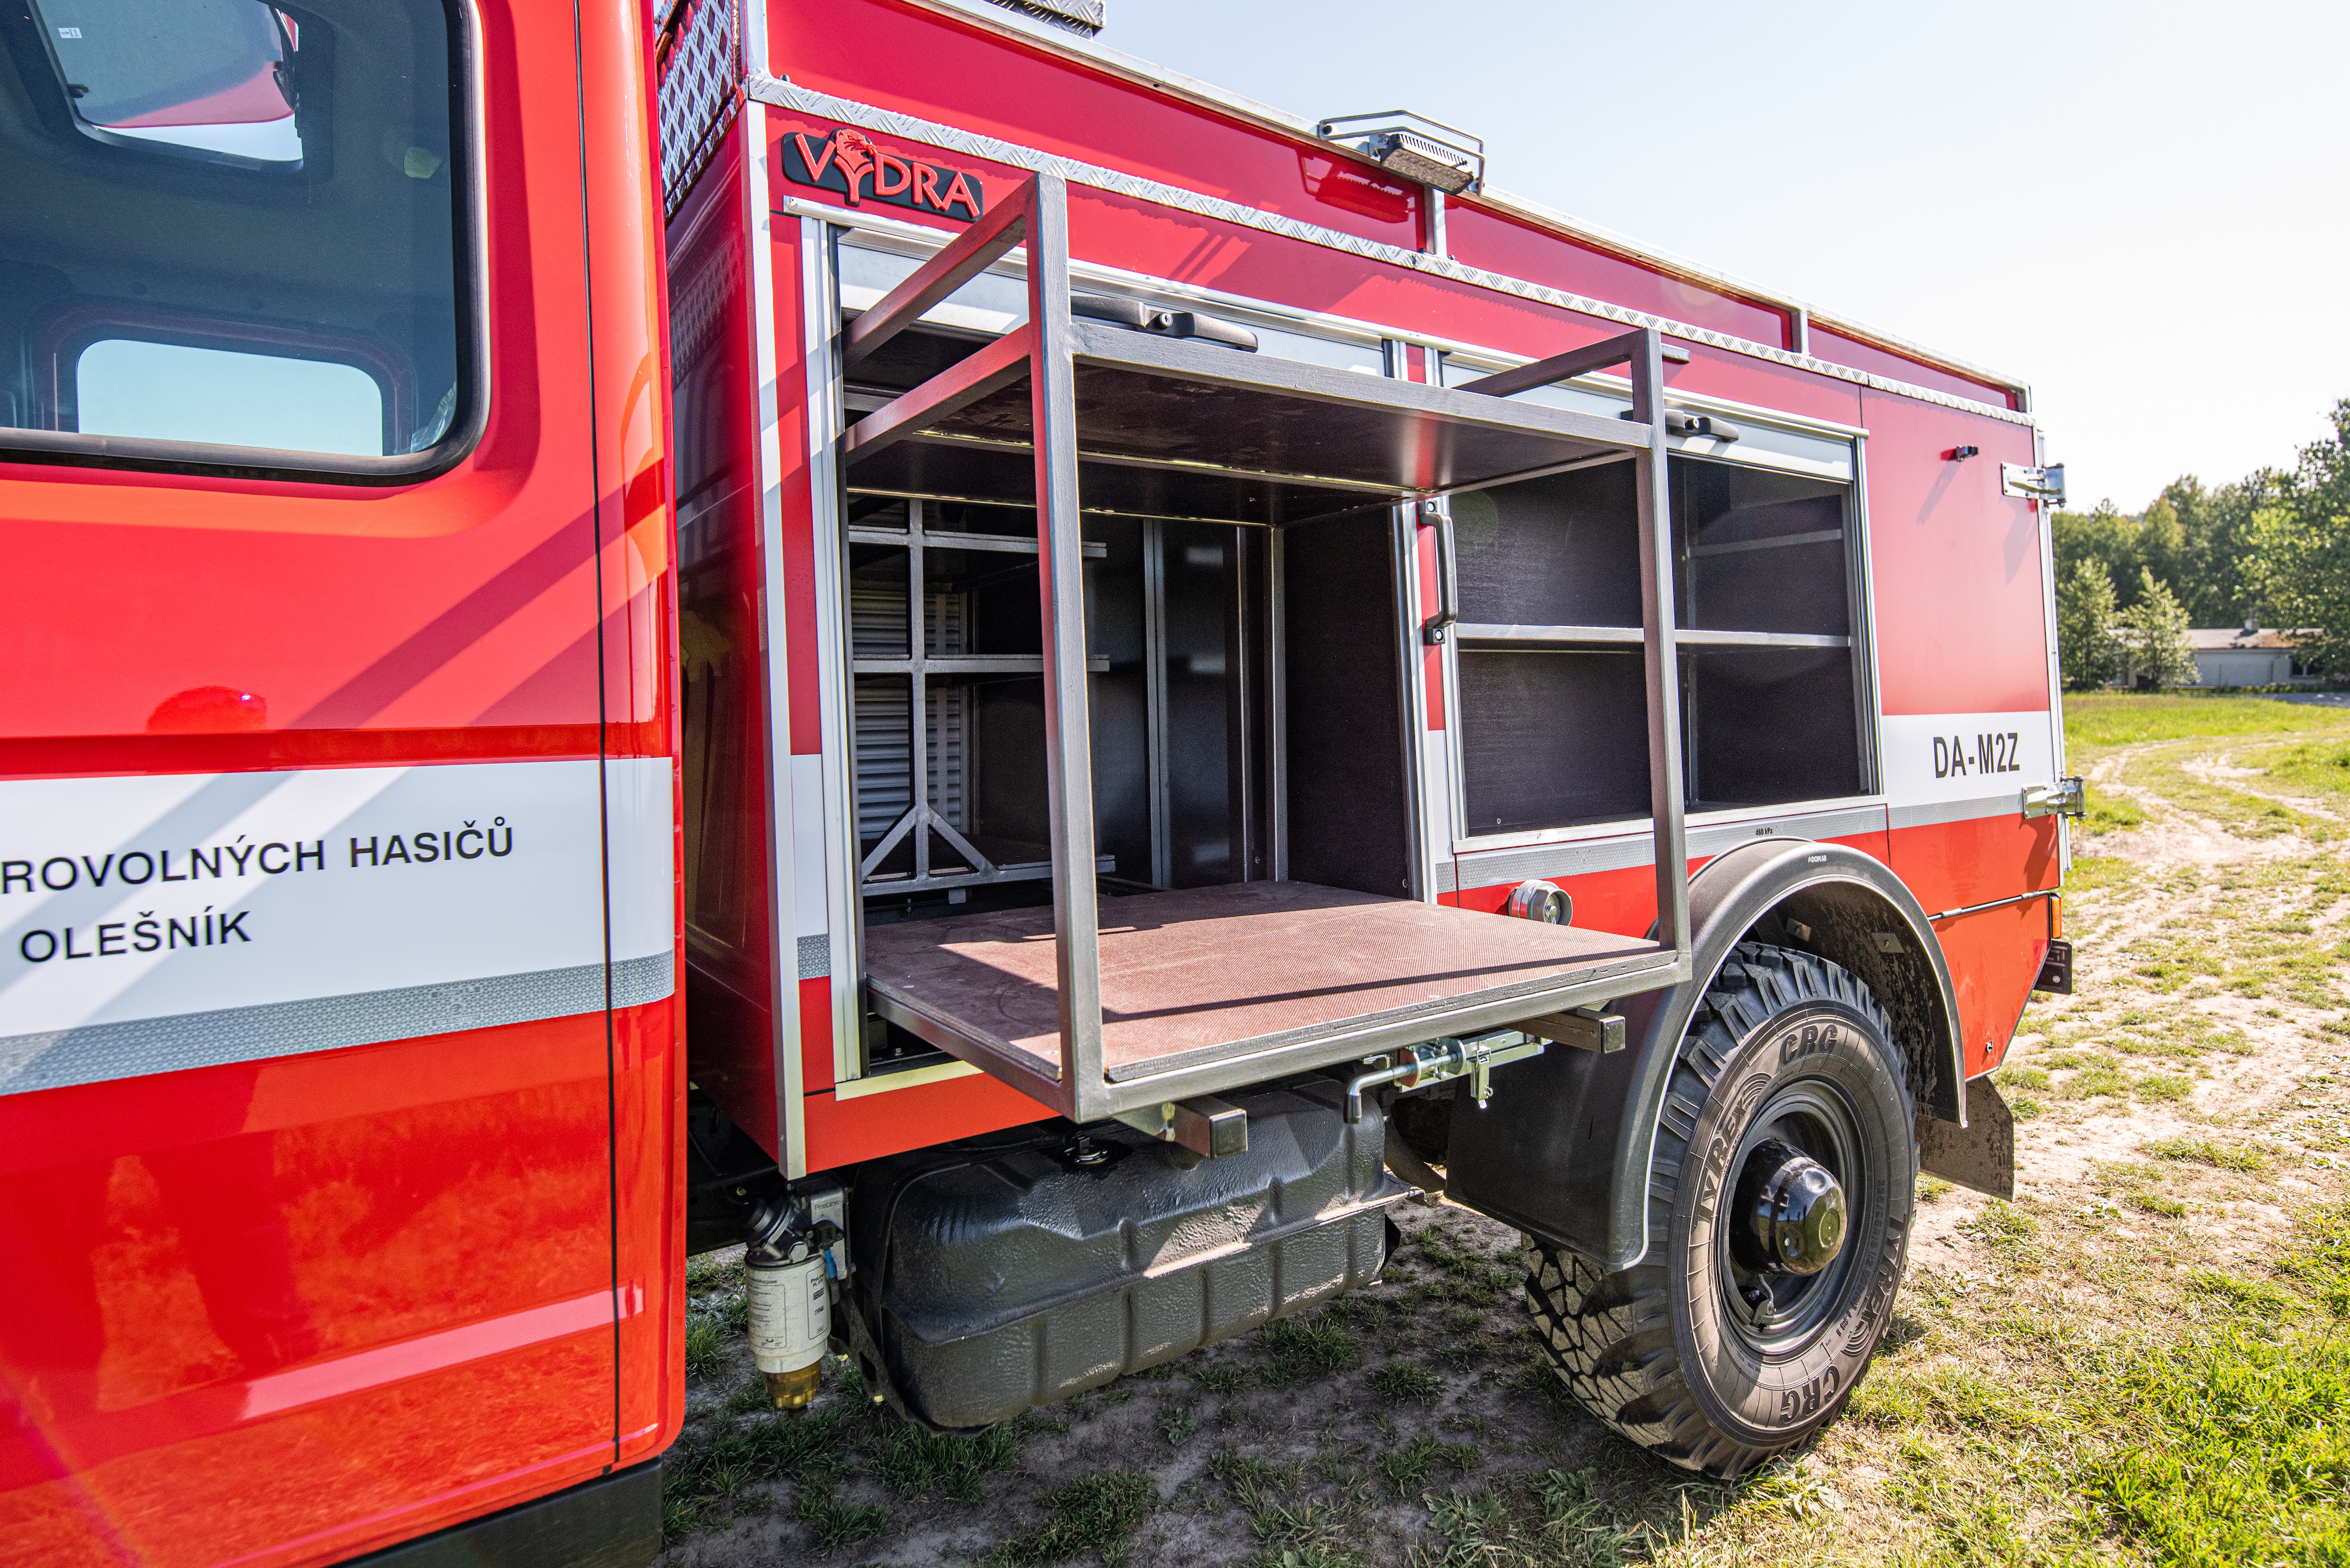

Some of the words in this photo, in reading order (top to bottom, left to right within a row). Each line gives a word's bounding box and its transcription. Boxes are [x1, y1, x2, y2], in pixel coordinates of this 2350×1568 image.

[794, 132, 980, 218] VYDRA
[1933, 732, 2020, 778] DA-M2Z
[1, 834, 325, 895] ROVOLNÝCH
[350, 816, 514, 868] HASIČŮ
[1756, 828, 1764, 836] 460
[19, 905, 252, 964] OLEŠNÍK
[1780, 1023, 1838, 1065] CRG
[814, 1200, 839, 1211] PreLine
[1780, 1365, 1840, 1424] CRG
